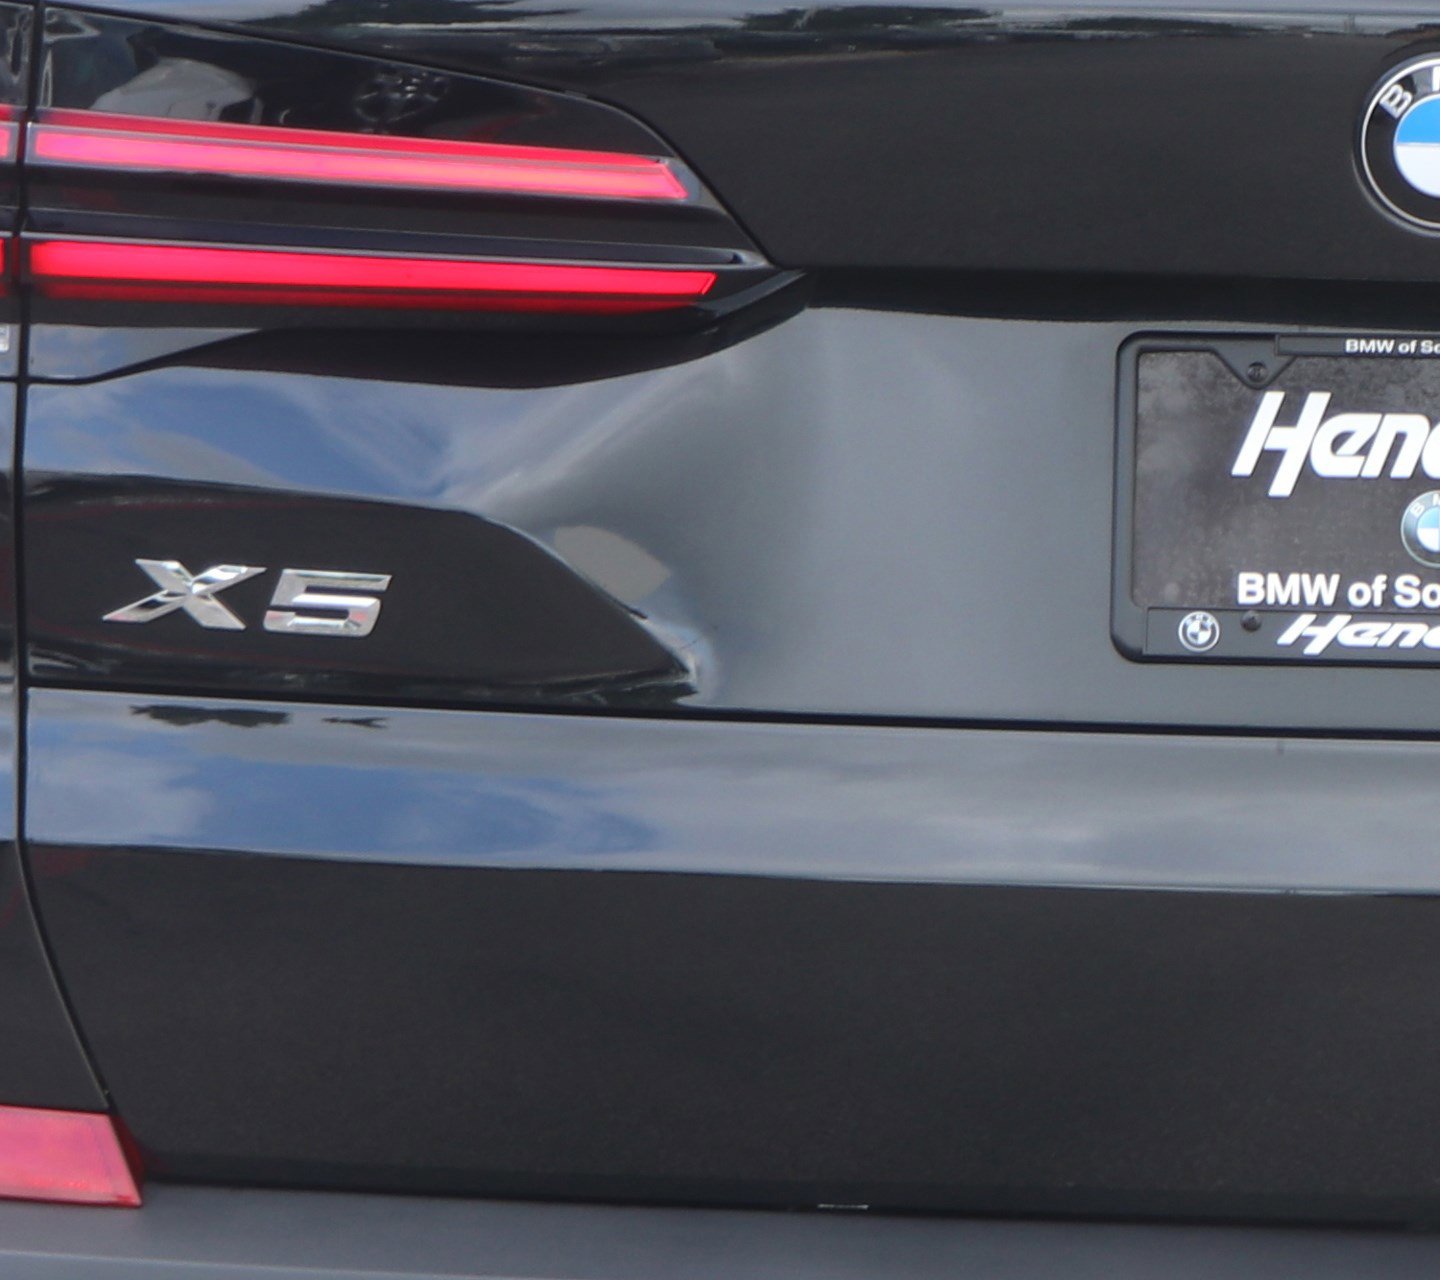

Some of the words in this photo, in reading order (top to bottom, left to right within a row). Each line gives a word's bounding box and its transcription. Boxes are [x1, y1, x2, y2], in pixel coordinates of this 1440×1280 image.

[1345, 338, 1395, 354] BMW
[1397, 339, 1418, 354] of
[102, 558, 392, 637] X5
[1237, 572, 1341, 606] BMW
[1347, 573, 1389, 608] of
